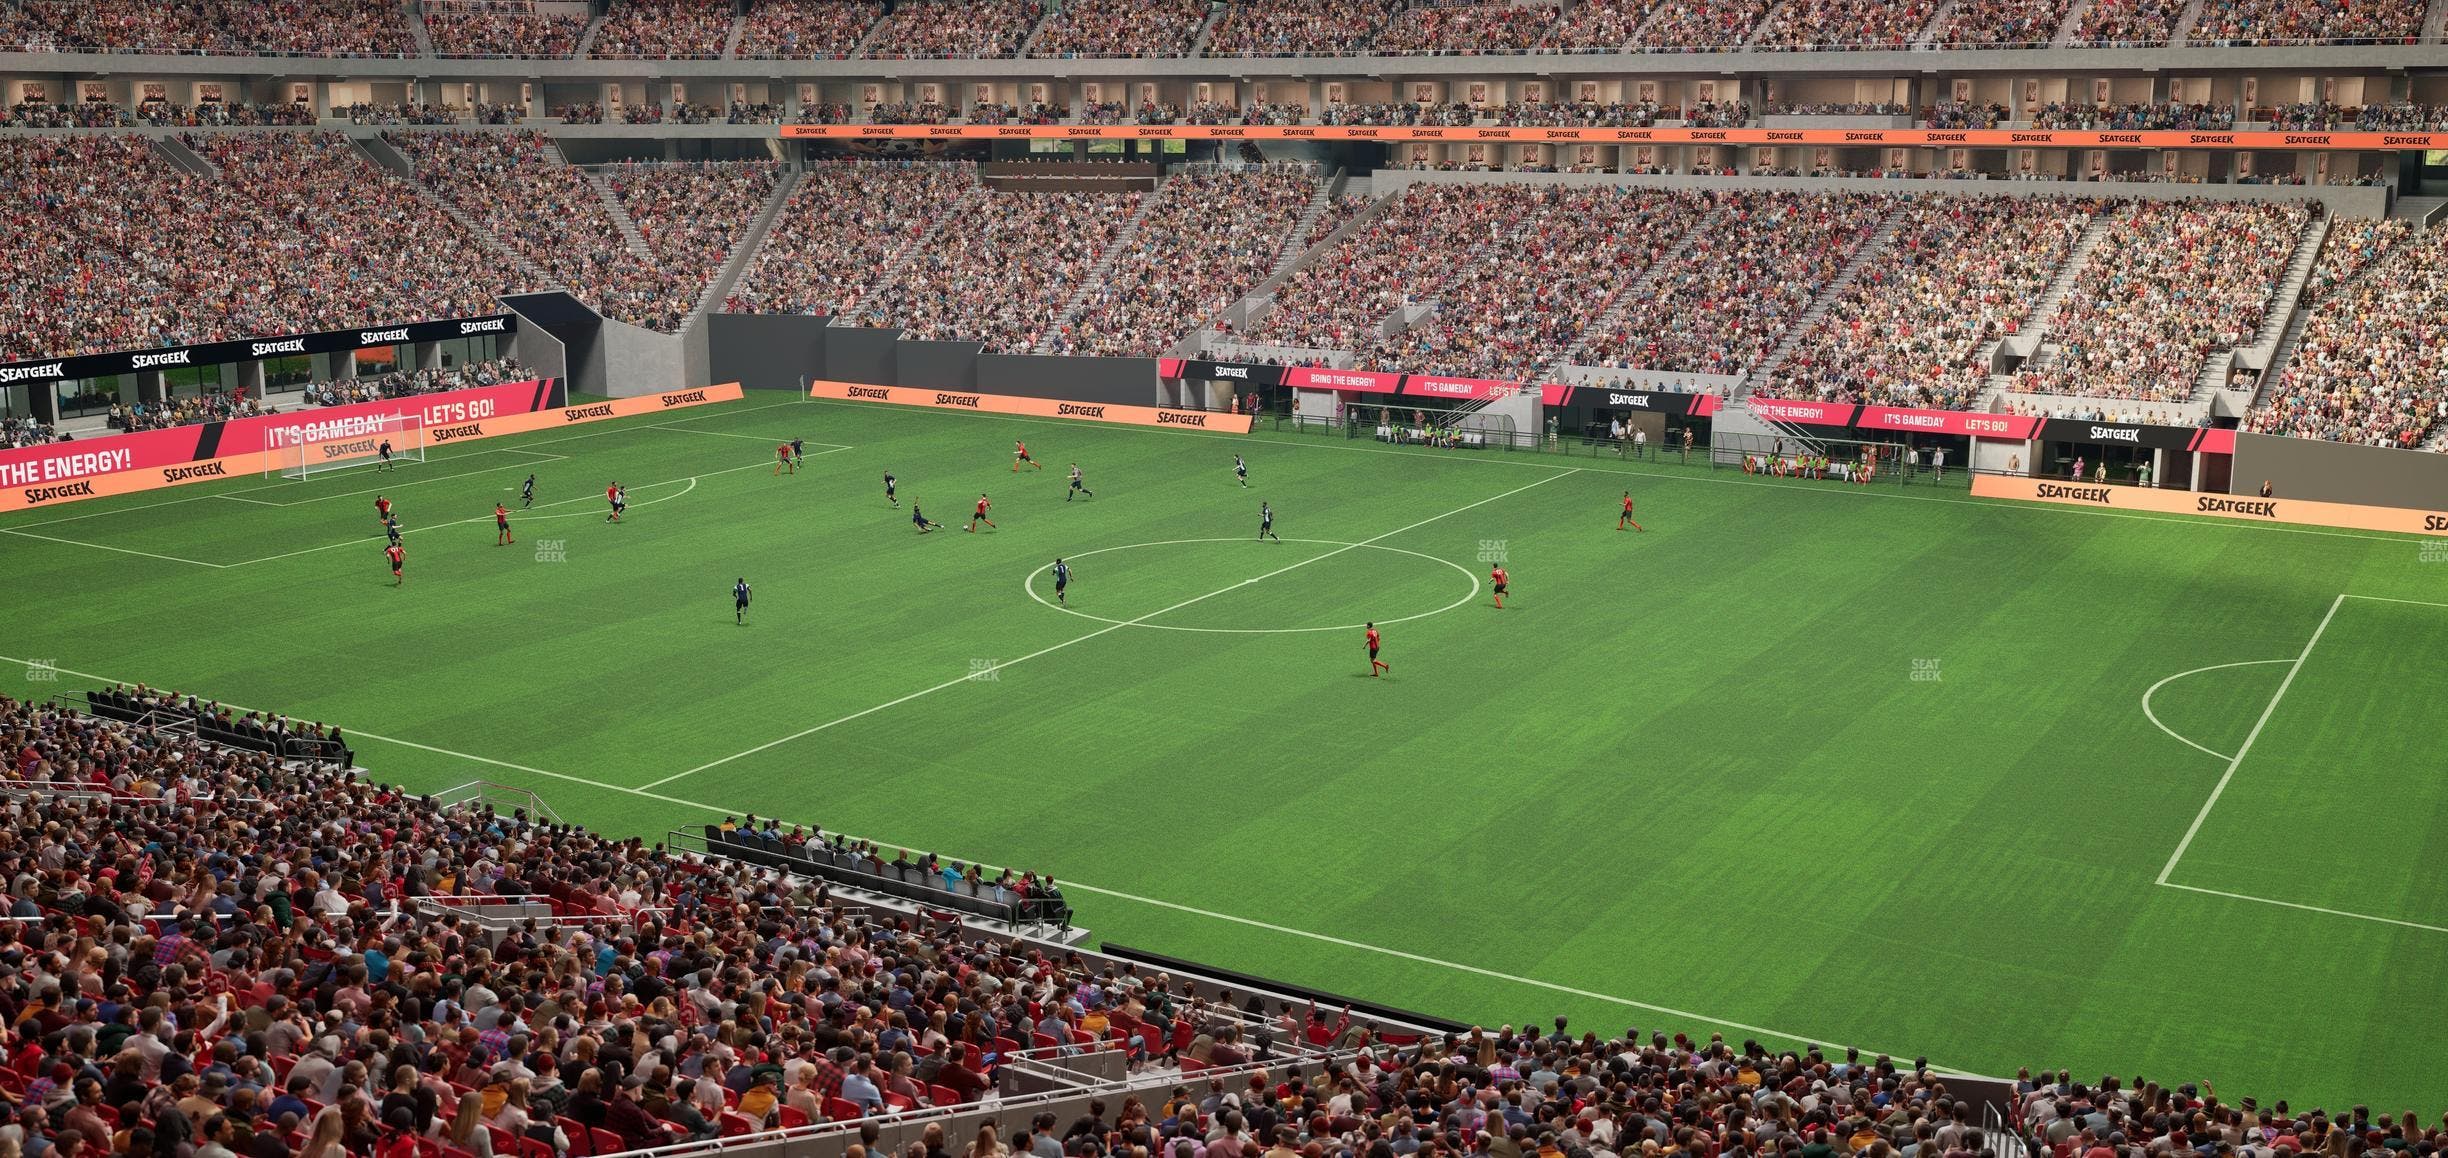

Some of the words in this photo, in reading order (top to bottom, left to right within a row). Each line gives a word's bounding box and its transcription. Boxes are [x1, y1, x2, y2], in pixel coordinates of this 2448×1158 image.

[1139, 128, 1172, 136] SEATGEEK
[1283, 129, 1314, 137] SEATGEEK
[1348, 129, 1377, 137] SEATGEEK
[1412, 129, 1442, 137] SEATGEEK
[1479, 130, 1510, 138] SEATGEEK
[1547, 130, 1579, 139] SEATGEEK
[1618, 131, 1651, 139] SEATGEEK
[1691, 131, 1726, 140] SEATGEEK
[1767, 131, 1803, 141] SEATGEEK
[1846, 132, 1883, 141] SEATGEEK
[1927, 133, 1966, 142] SEATGEEK
[2012, 133, 2052, 143] SEATGEEK
[2099, 134, 2141, 144] SEATGEEK
[2191, 134, 2234, 144] SEATGEEK
[2285, 135, 2330, 145] SEATGEEK
[2384, 135, 2430, 146] SEATGEEK
[460, 318, 505, 335] SEATGEEK
[361, 328, 409, 345] SEATGEEK
[252, 338, 305, 357] SEATGEEK
[132, 350, 190, 369] SEATGEEK
[0, 362, 64, 383] SEATGEEK
[1215, 365, 1248, 380] SEATGEEK
[1310, 374, 1331, 385] BRING
[1332, 375, 1345, 386] THE
[1347, 375, 1376, 387] ENERGY!
[1424, 381, 1437, 393] IT'S
[1439, 382, 1474, 395] GAMEDAY
[661, 390, 706, 406] SEATGEEK
[847, 385, 889, 400] SEATGEEK
[935, 393, 980, 407] SEATGEEK
[1609, 393, 1649, 408] SEATGEEK
[565, 403, 614, 421] SEATGEEK
[1057, 403, 1105, 418] SEATGEEK
[1770, 405, 1786, 417] THE
[1788, 407, 1823, 419] ENERGY!
[269, 425, 300, 447] IT'S
[306, 414, 385, 442] GAMEDAY
[423, 402, 465, 425] LET'S
[468, 398, 495, 419] GO!
[1156, 411, 1206, 427] SEATGEEK
[1884, 413, 1901, 426] IT'S
[1902, 414, 1945, 428] GAMEDAY
[1965, 419, 1989, 431] LET'S
[1990, 420, 2008, 432] GO!
[432, 423, 483, 442] SEATGEEK
[2090, 426, 2139, 443] SEATGEEK
[323, 439, 378, 458] SEATGEEK
[0, 460, 39, 486] THE
[44, 448, 131, 481] ENERGY!
[163, 461, 226, 483] SEATGEEK
[25, 480, 95, 503] SEATGEEK
[2036, 482, 2111, 504] SEATGEEK
[2197, 496, 2277, 518] SEATGEEK
